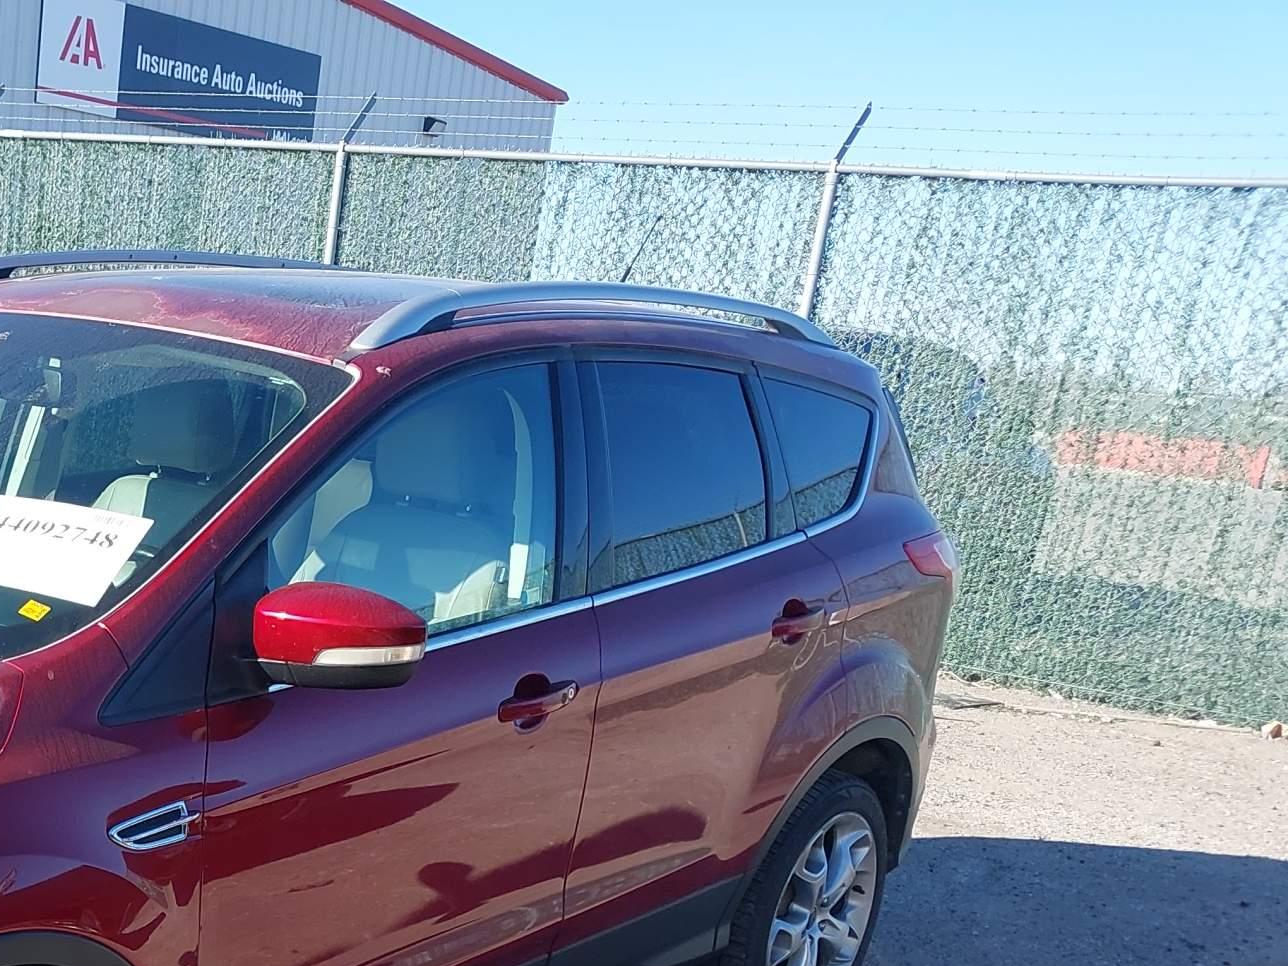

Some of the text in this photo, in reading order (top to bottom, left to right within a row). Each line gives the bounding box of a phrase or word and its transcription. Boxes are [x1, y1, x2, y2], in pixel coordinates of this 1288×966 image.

[136, 44, 304, 108] Insurance Auto Auctions
